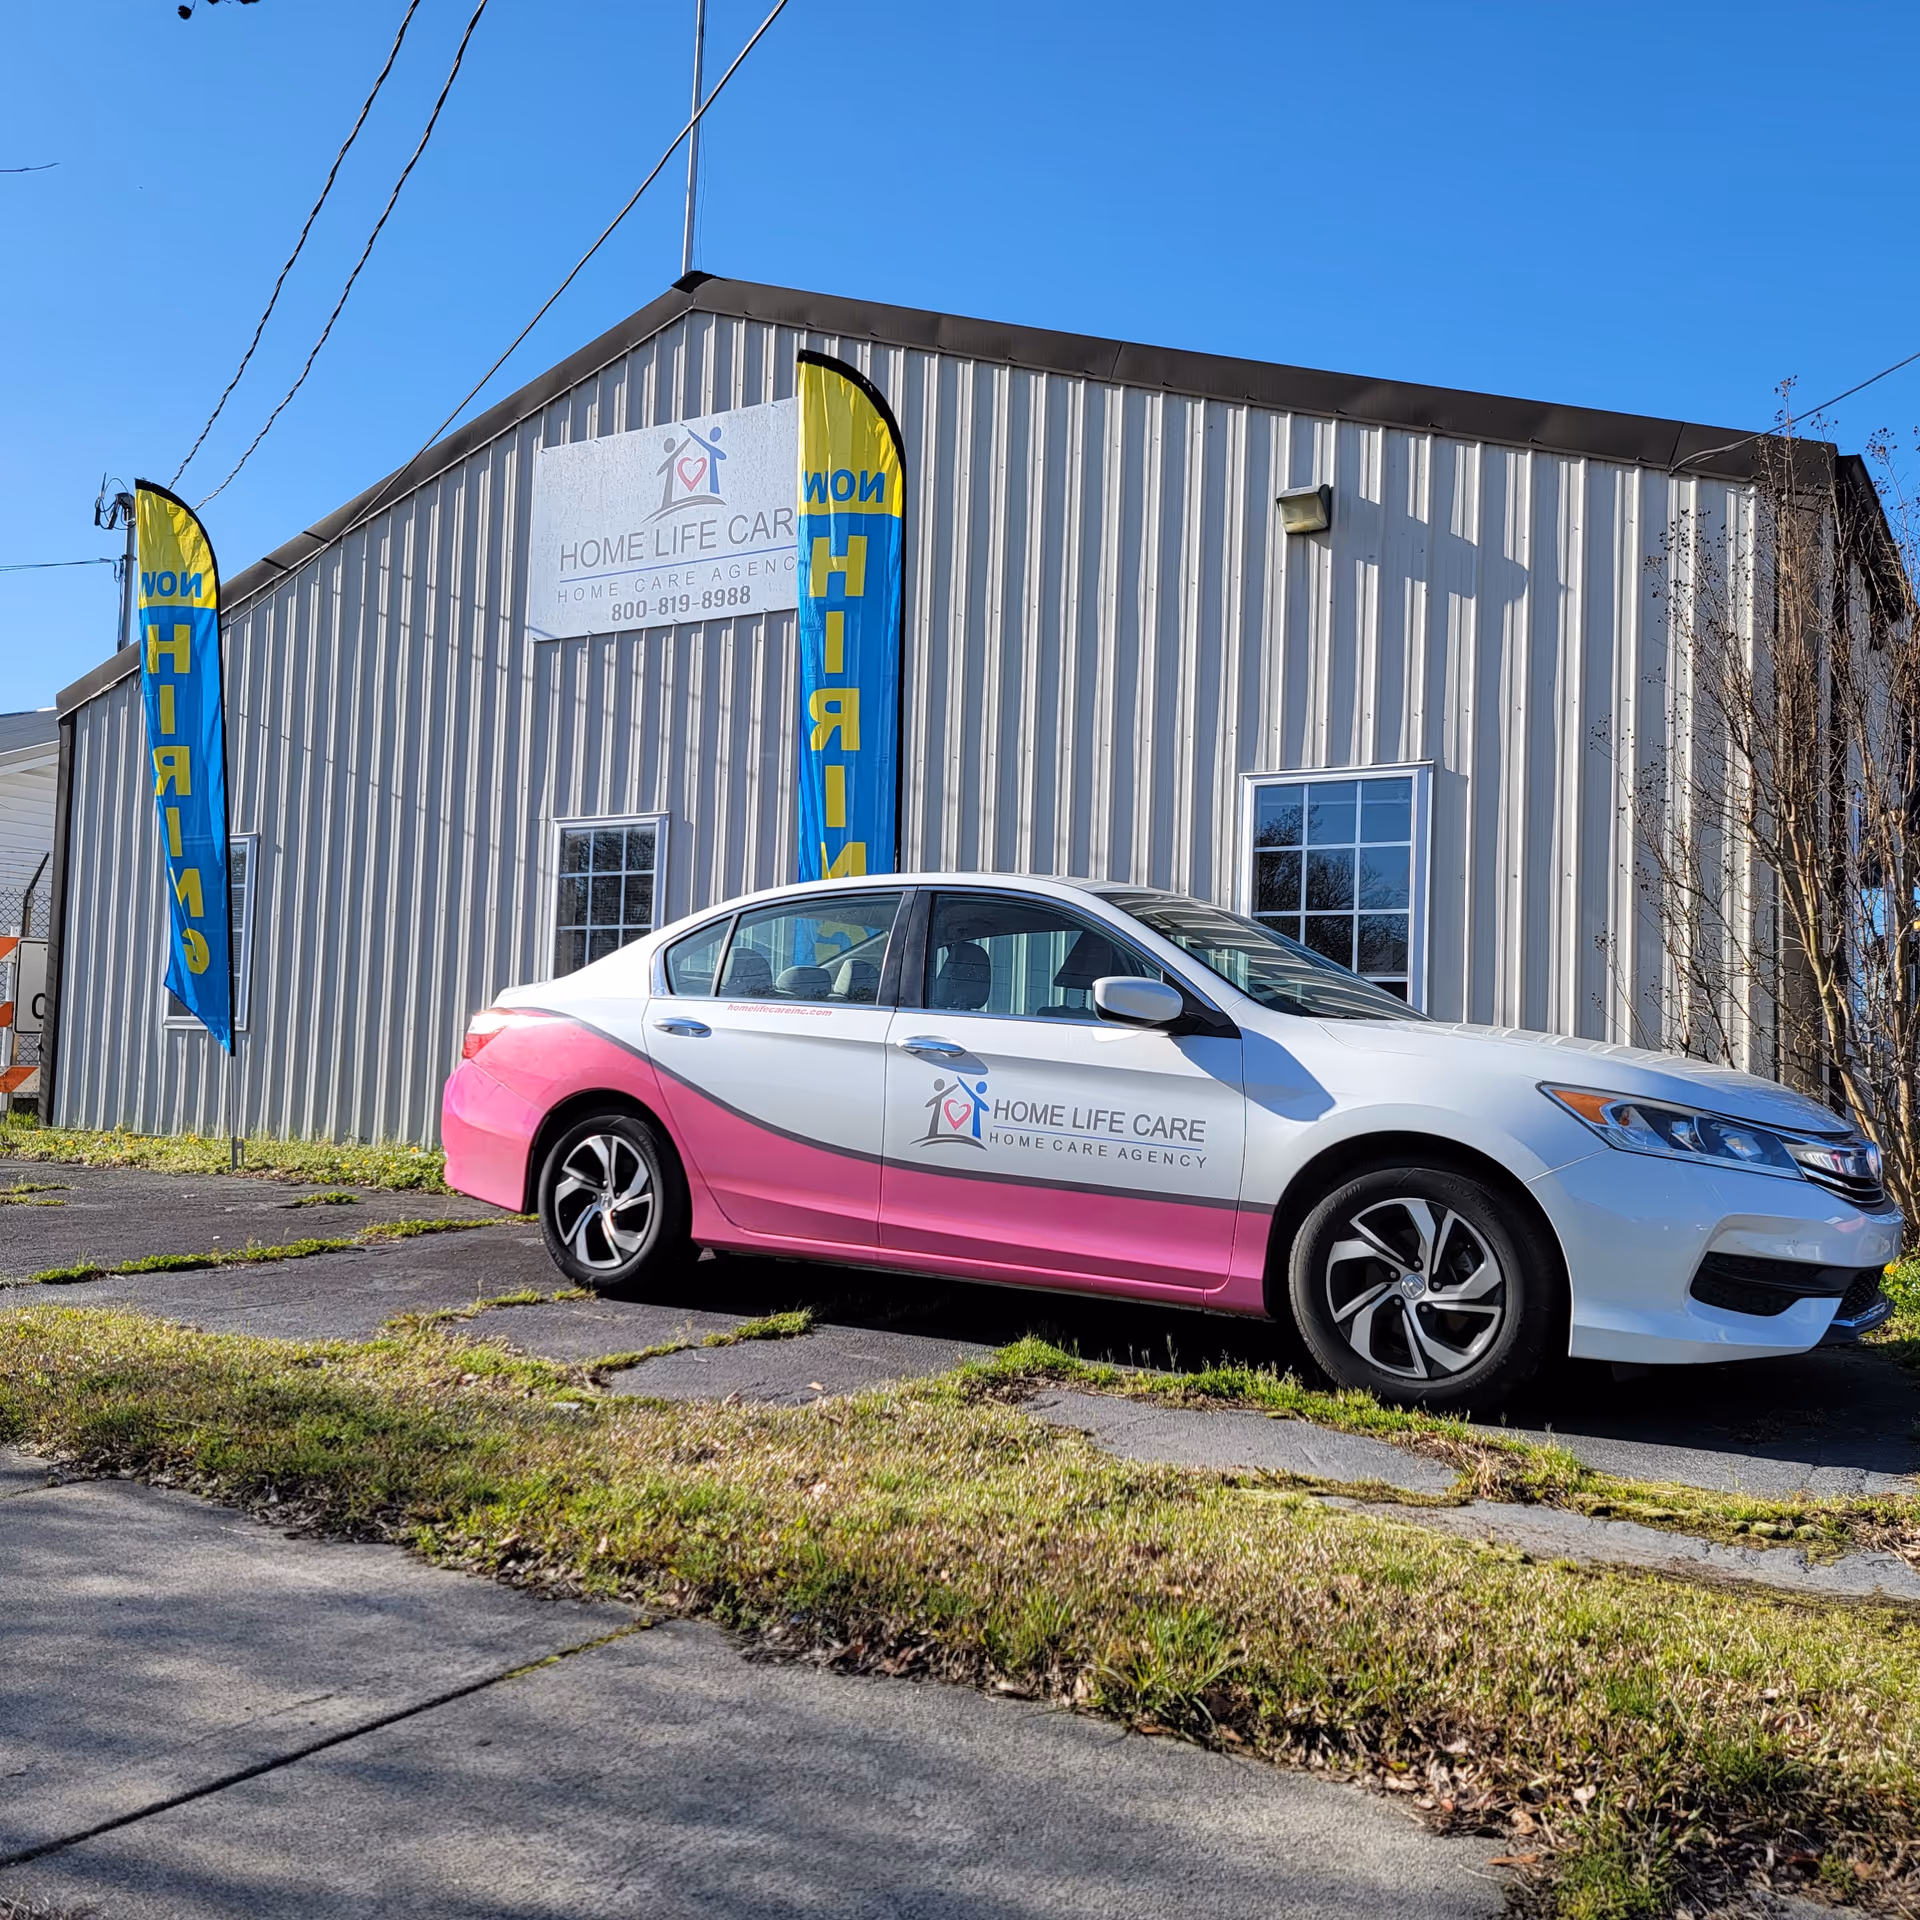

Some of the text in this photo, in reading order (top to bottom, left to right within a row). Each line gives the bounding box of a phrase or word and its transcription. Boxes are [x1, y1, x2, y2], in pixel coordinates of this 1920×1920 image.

[560, 507, 795, 572] HOME LIFE CAR
[557, 556, 796, 604] HOME CARE AGENC
[611, 585, 751, 622] 800-819-8988
[727, 1003, 833, 1017] homelifecareinc.com
[993, 1098, 1207, 1143] HOME LIFE CARE
[989, 1132, 1208, 1169] HOME CARE AGENCY
